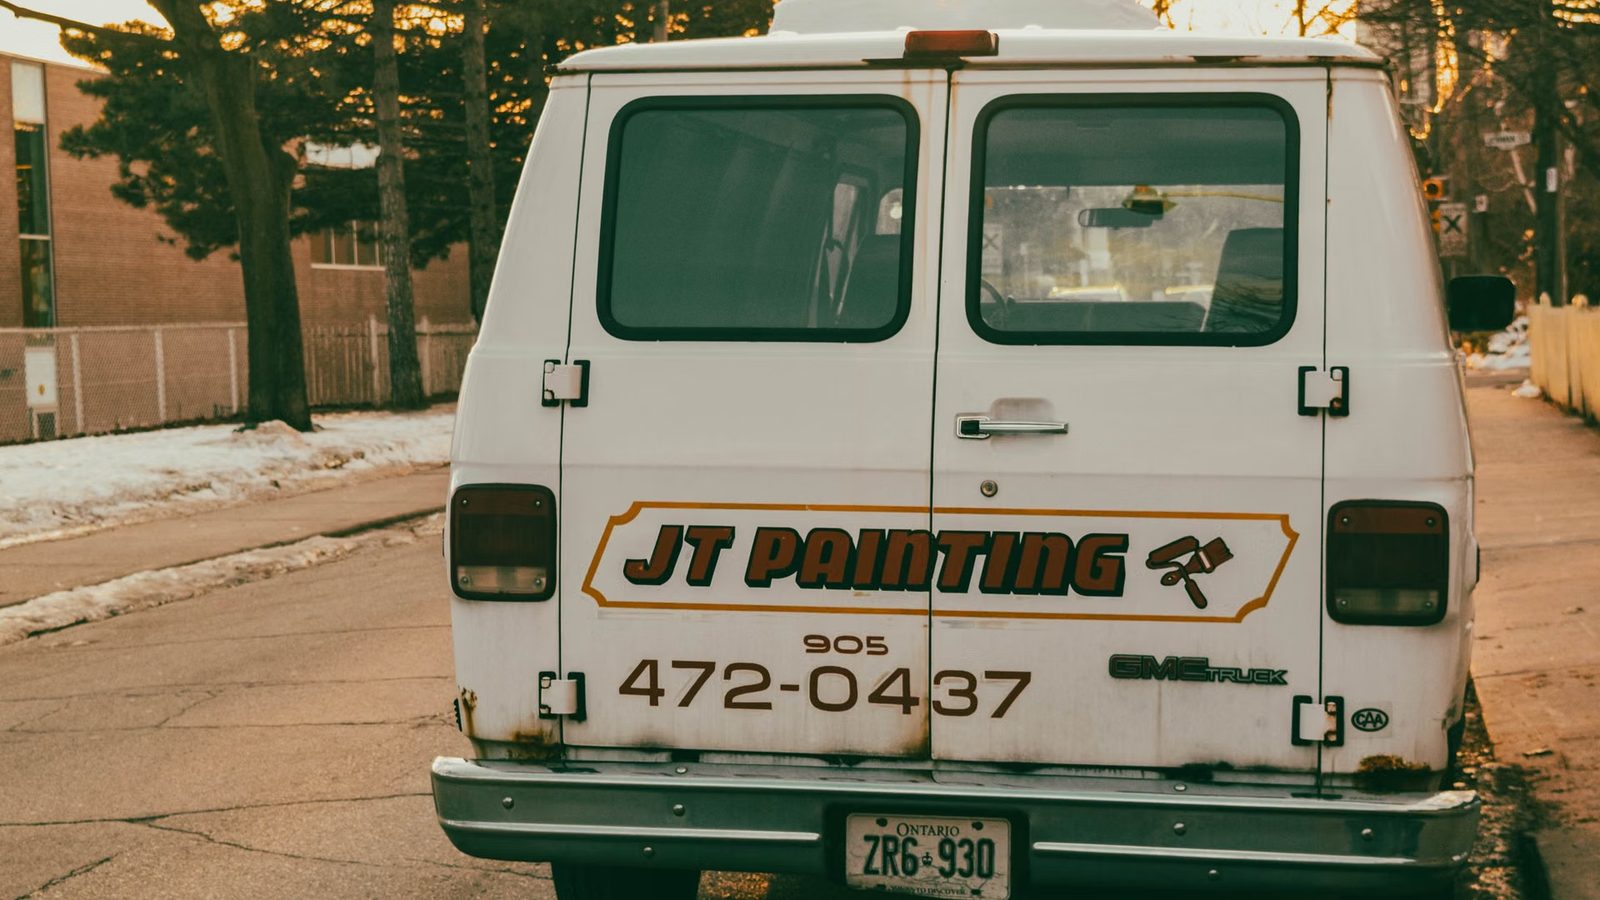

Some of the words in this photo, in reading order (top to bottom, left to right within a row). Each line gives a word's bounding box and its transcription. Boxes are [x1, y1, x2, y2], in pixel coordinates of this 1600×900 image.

[623, 524, 736, 587] JT
[744, 526, 1129, 598] PAINTING
[803, 634, 889, 656] 905
[618, 659, 1032, 719] 472-0437
[1356, 711, 1383, 728] CAA
[896, 822, 960, 838] ONTARIO
[863, 834, 919, 876] ZR6
[938, 838, 995, 879] 930
